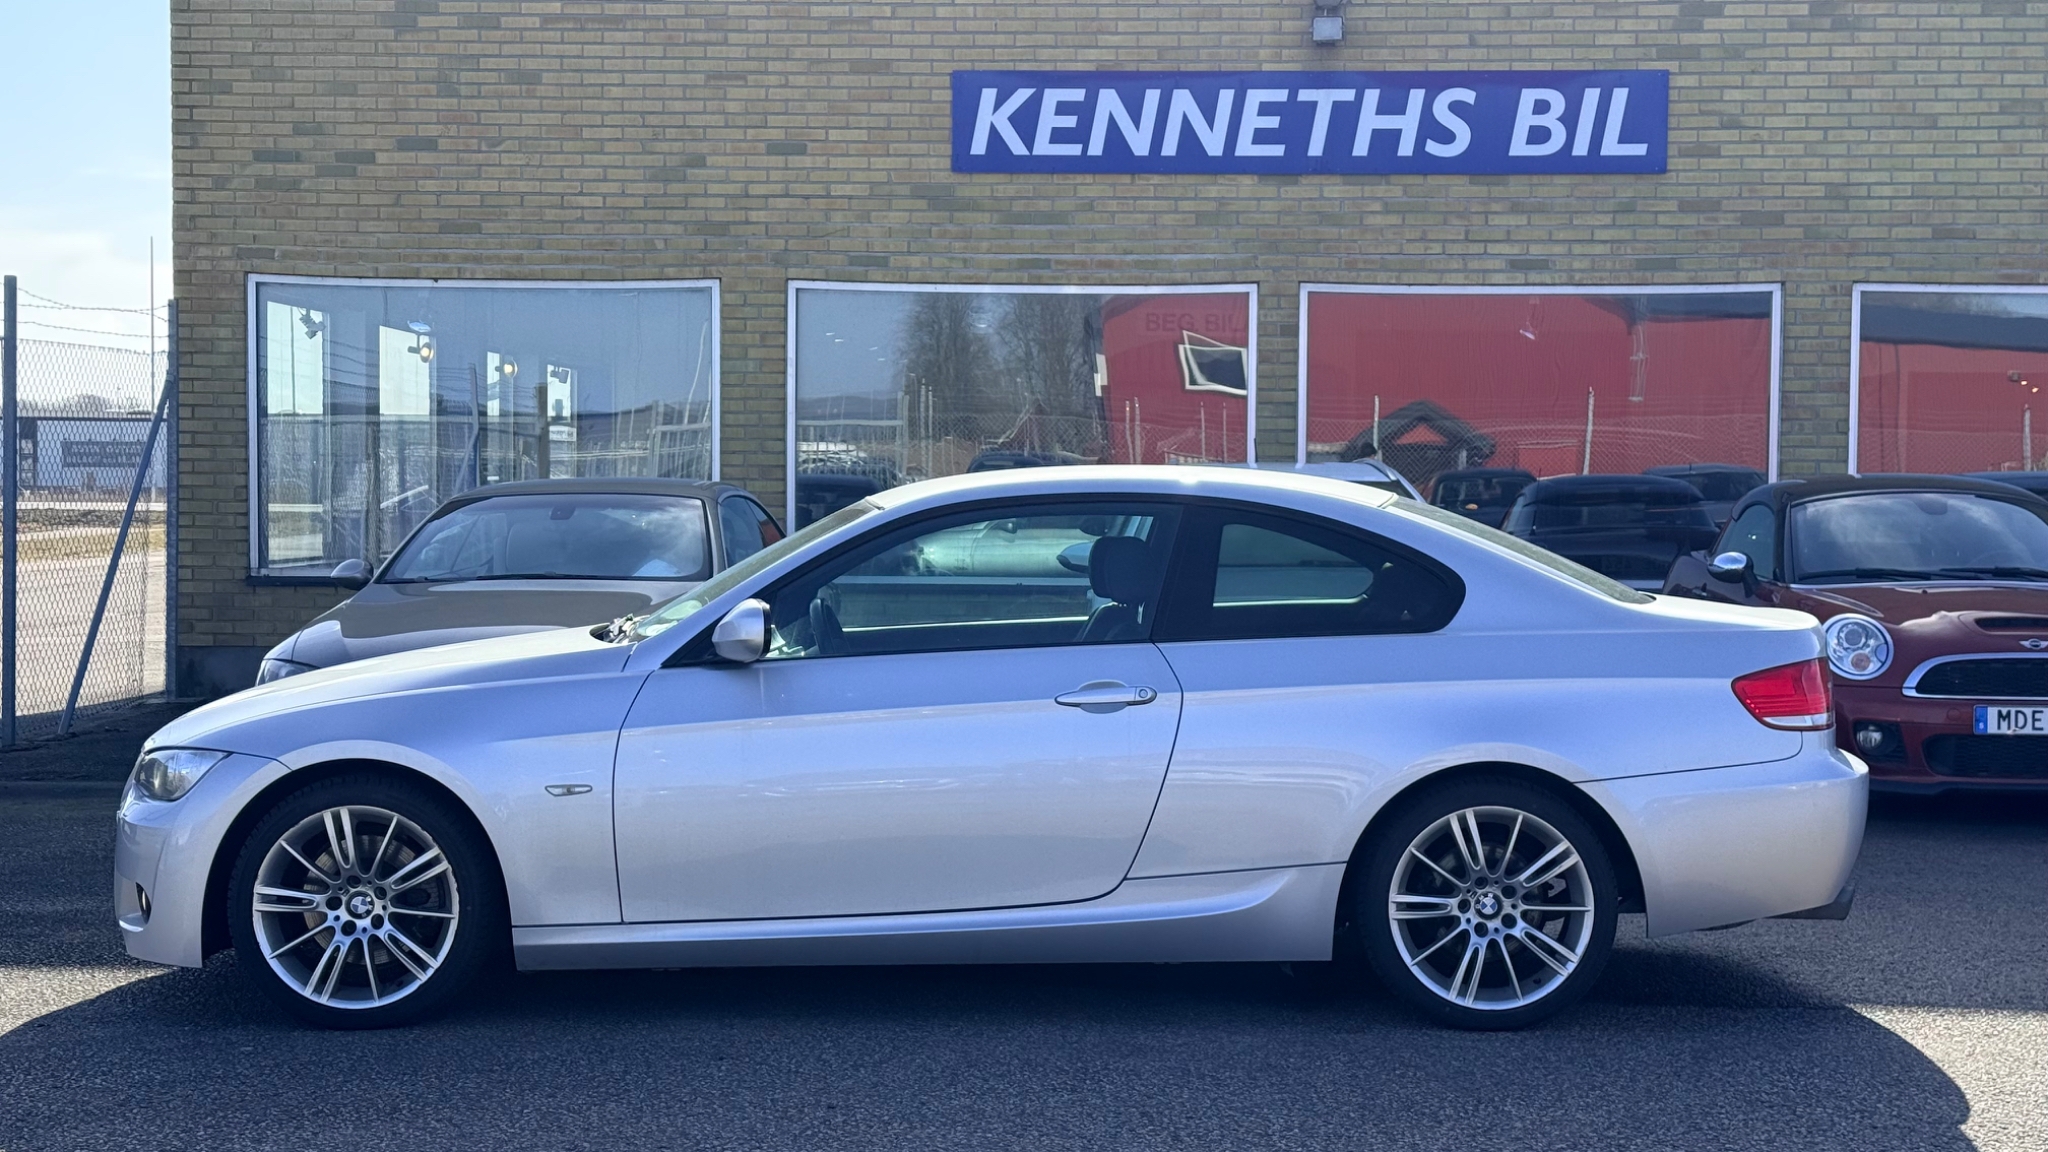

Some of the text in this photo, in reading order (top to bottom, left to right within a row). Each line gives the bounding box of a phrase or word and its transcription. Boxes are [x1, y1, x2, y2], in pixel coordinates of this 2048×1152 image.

[969, 87, 1649, 157] KENNETHS BIL
[1997, 709, 2044, 731] MDE
